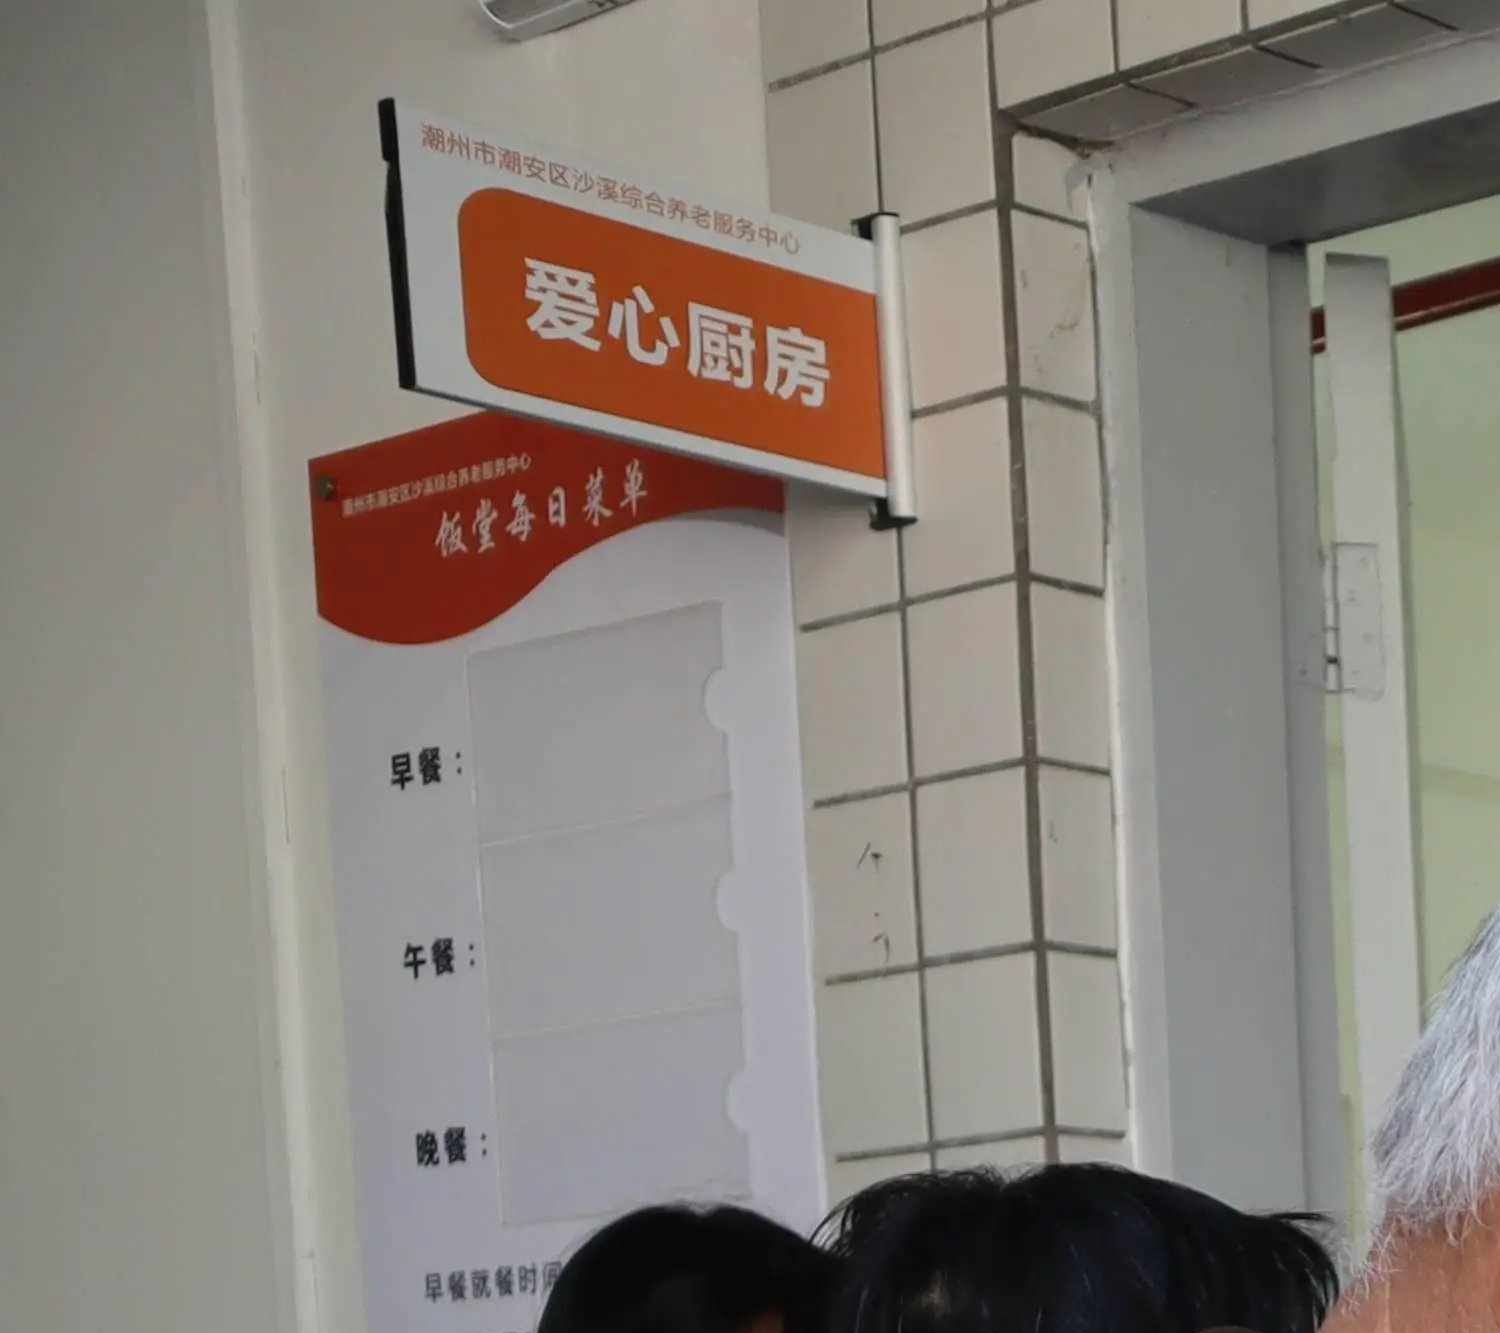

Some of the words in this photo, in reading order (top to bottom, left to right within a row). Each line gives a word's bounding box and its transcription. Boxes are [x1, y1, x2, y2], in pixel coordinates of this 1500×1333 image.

[420, 122, 802, 256] 潮州市潮安区沙溪综合养老服务中心
[523, 256, 832, 408] 爱心厨房
[434, 457, 649, 557] 饭堂每日菜单
